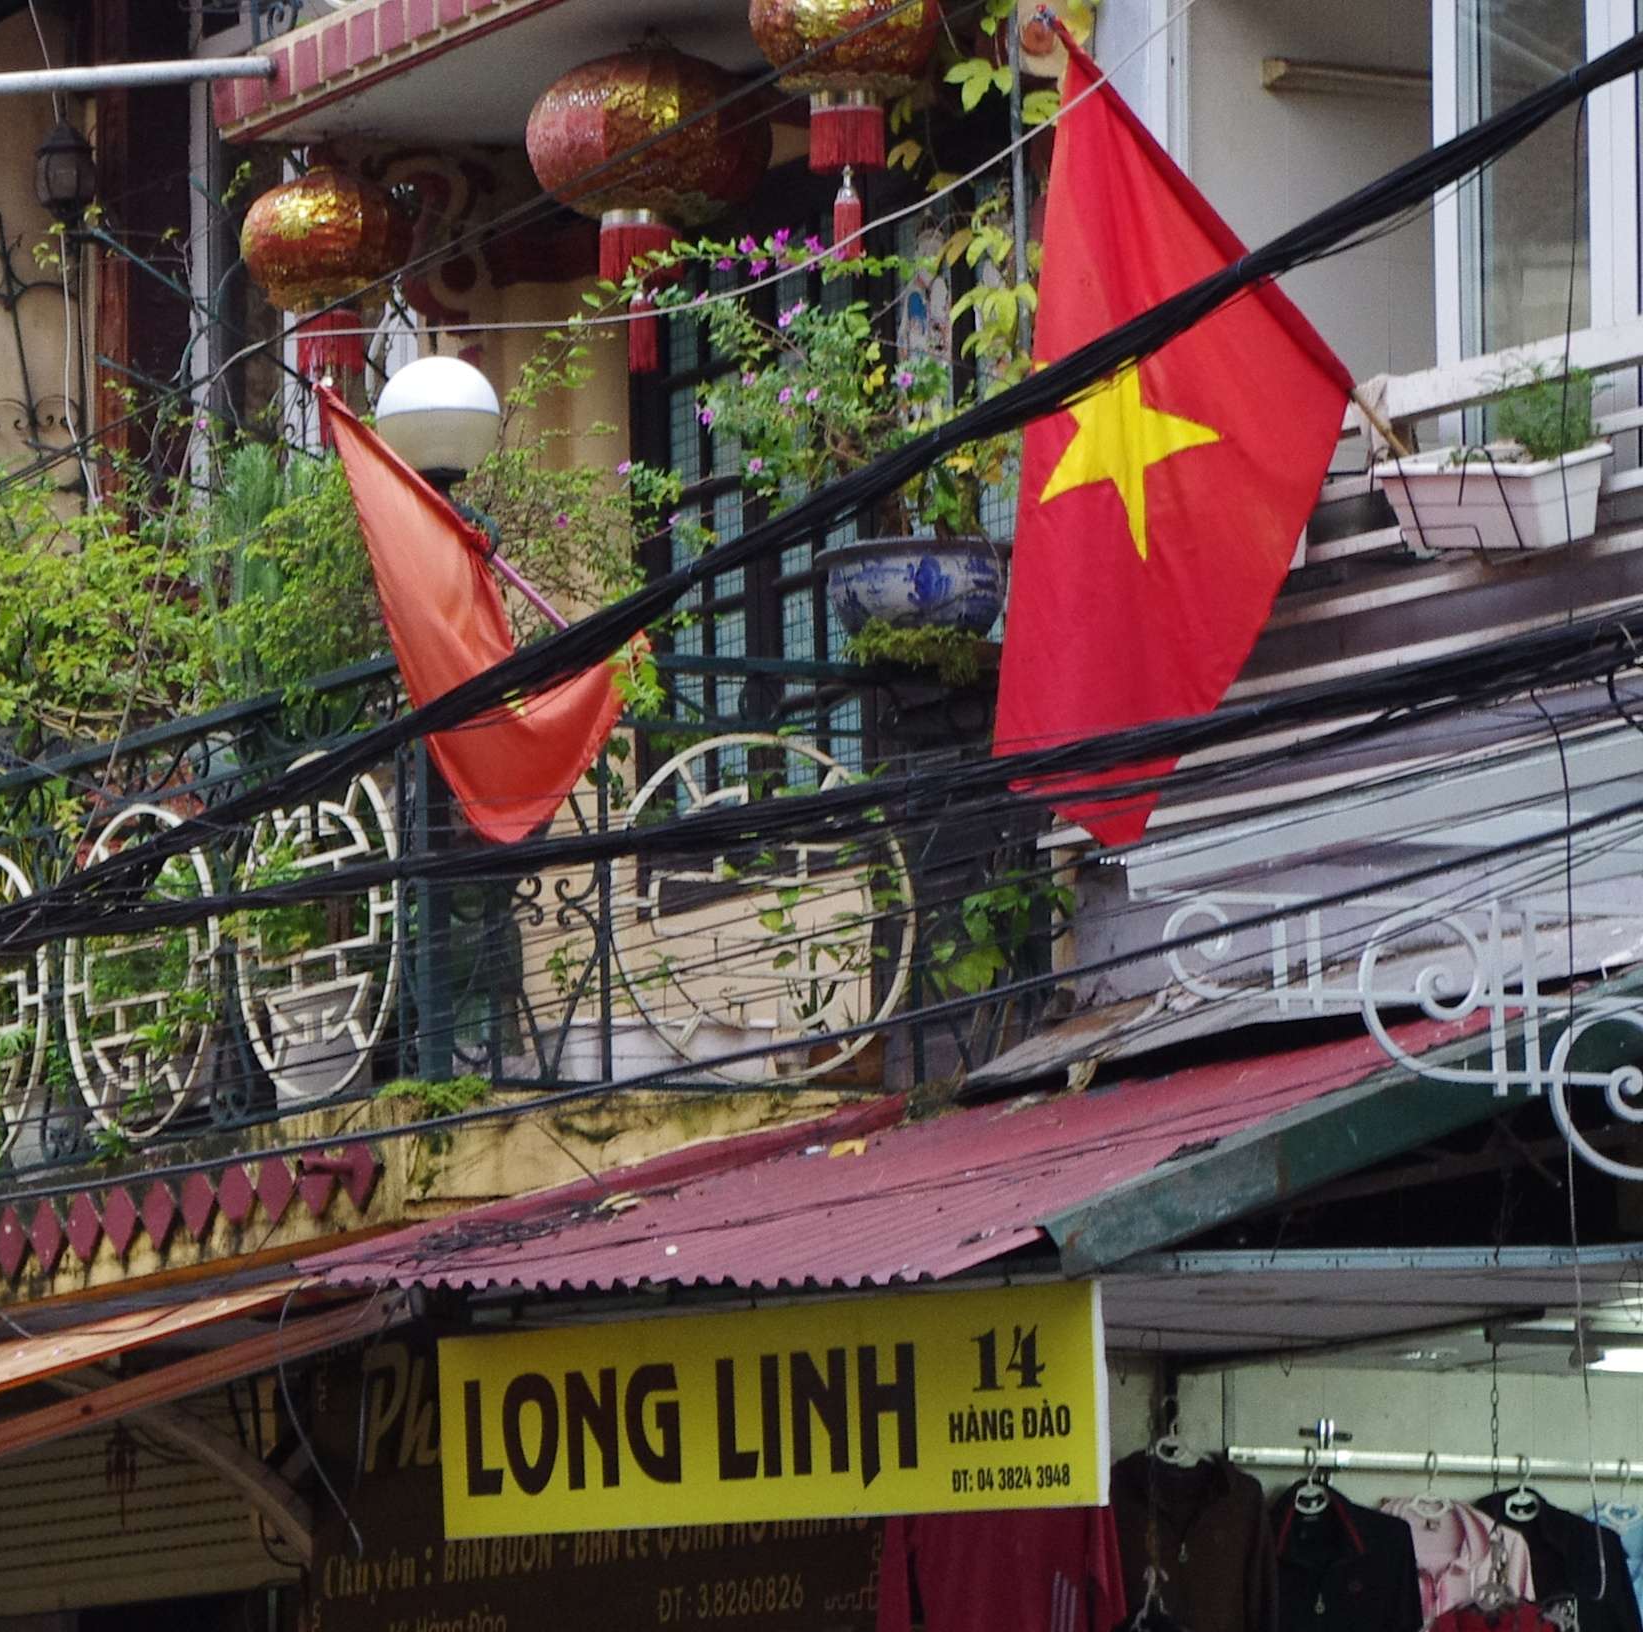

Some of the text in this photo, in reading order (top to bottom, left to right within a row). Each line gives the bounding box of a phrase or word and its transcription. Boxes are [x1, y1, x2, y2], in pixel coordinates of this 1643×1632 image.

[970, 1322, 1045, 1392] 14
[463, 1341, 919, 1498] LONG LINH
[949, 1399, 1072, 1444] HÀNG ĐÀO
[951, 1463, 1071, 1494] ĐT: 04 3824 3948
[697, 1578, 805, 1620] 3.8260826
